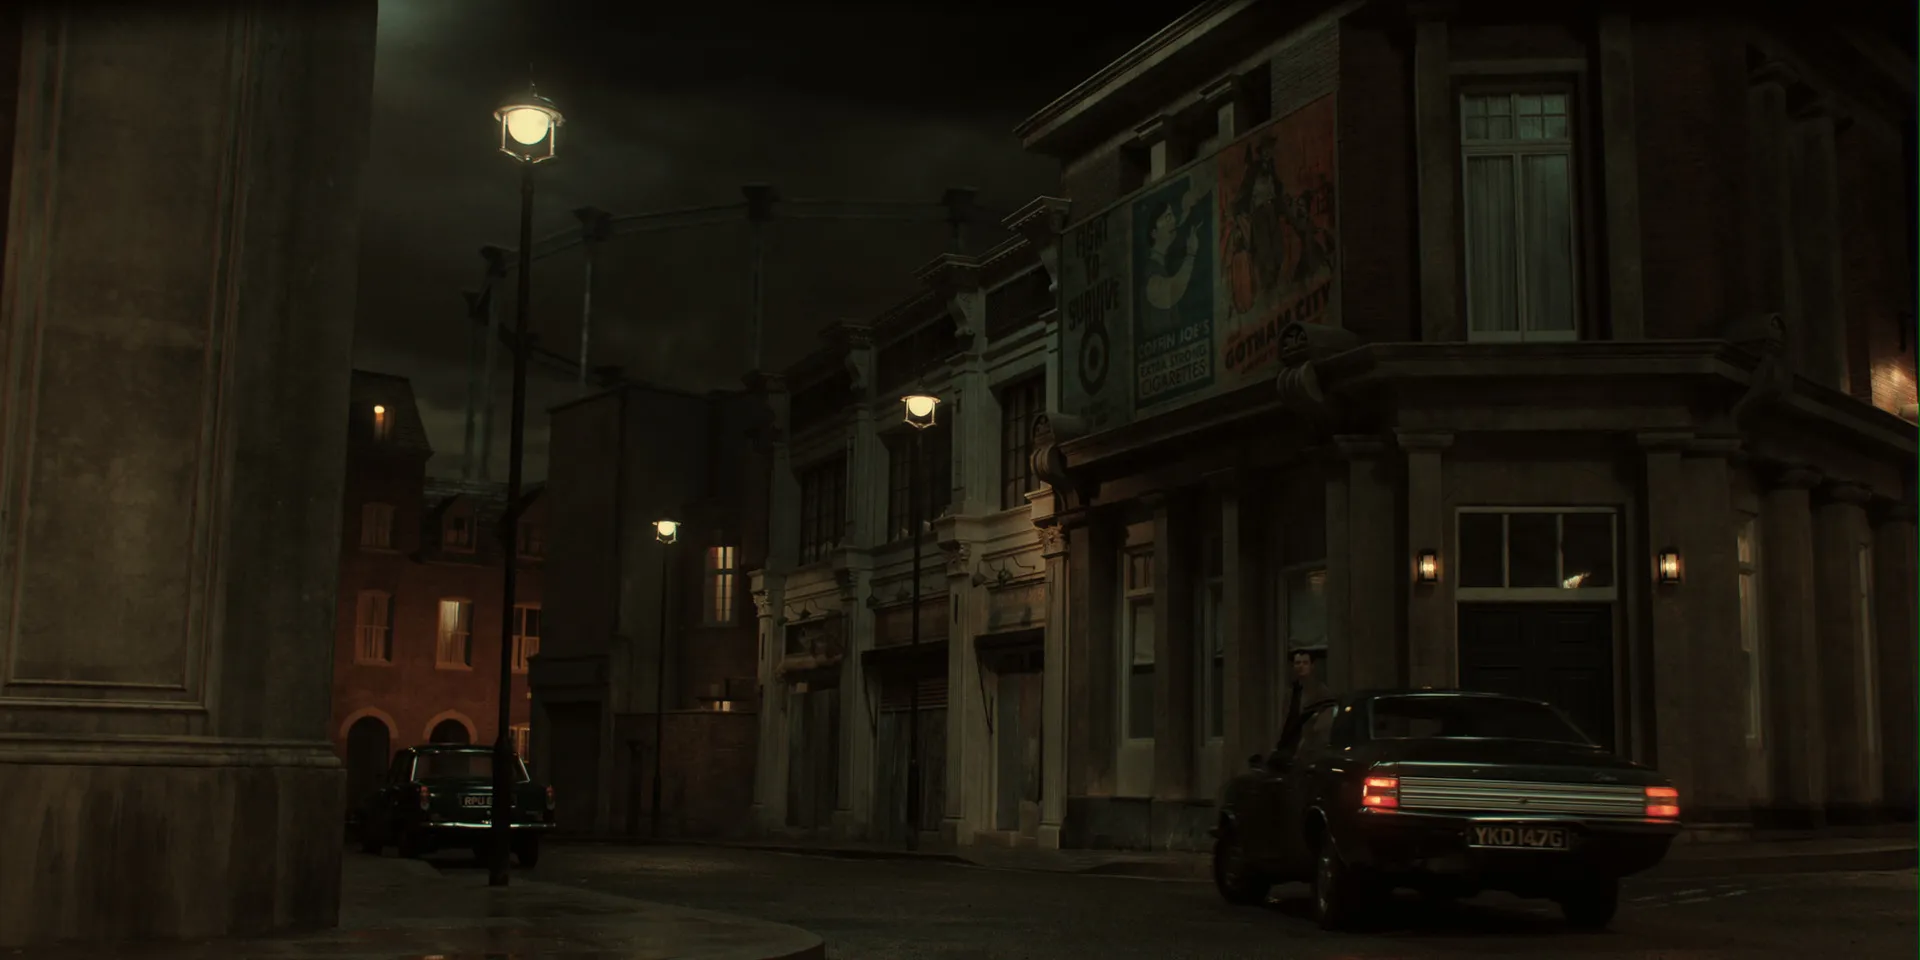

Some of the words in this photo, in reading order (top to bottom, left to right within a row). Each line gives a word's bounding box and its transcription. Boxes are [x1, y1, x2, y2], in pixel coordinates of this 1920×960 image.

[1076, 212, 1109, 258] FIGHT
[1084, 253, 1099, 285] TO
[1068, 276, 1120, 331] SURVIVE
[1225, 307, 1291, 369] GOTHAM
[1295, 279, 1331, 321] CITY
[1138, 330, 1176, 361] COFFIN
[1180, 318, 1211, 344] JOE'S
[1140, 358, 1167, 377] EXTRA
[1169, 344, 1206, 367] STRONG
[1142, 358, 1207, 395] CIGARETTES
